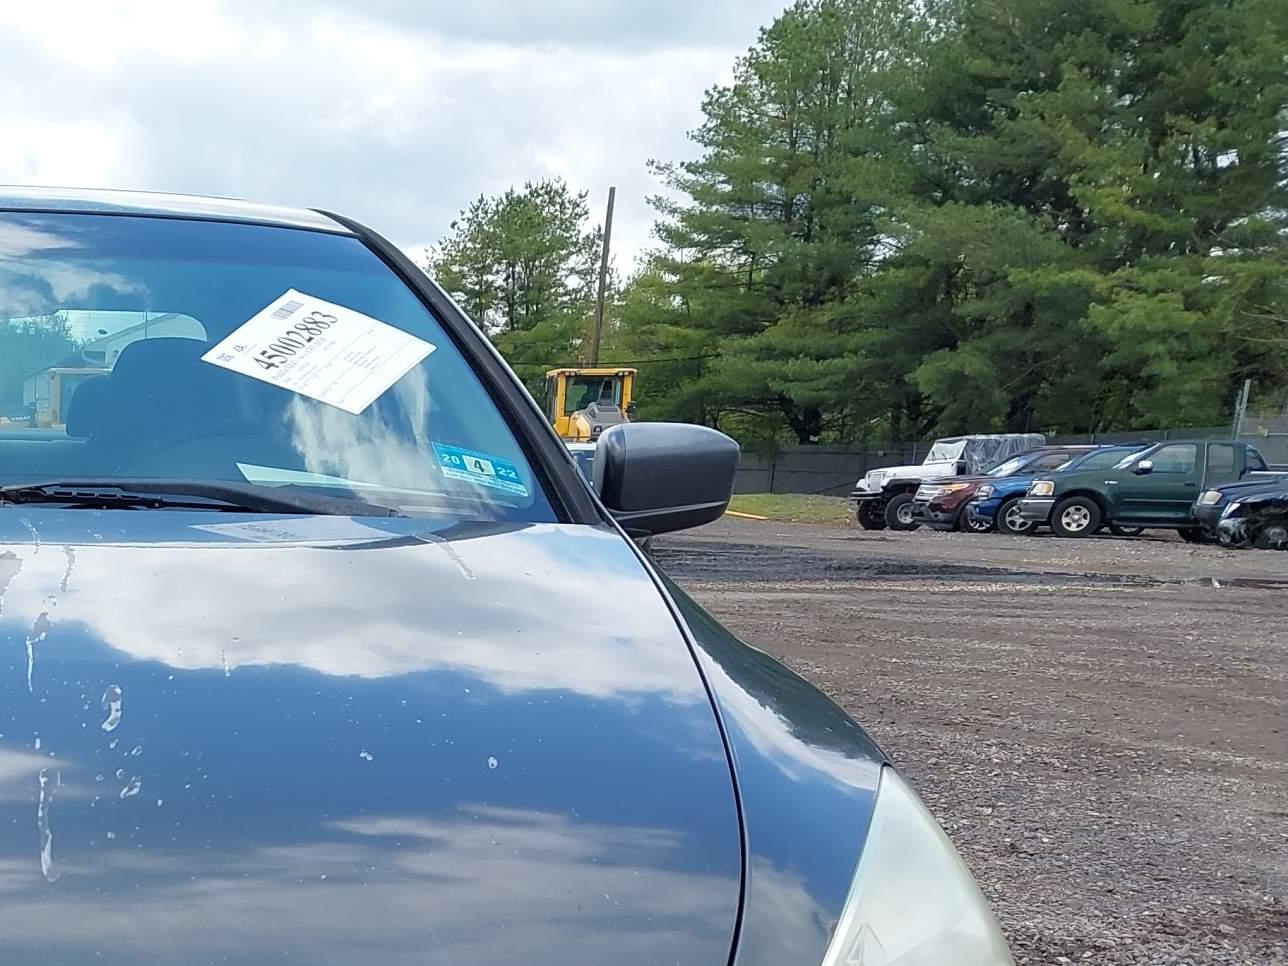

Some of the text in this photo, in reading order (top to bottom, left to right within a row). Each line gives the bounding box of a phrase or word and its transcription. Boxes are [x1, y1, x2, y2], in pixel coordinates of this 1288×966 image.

[253, 311, 338, 370] 45002883
[441, 454, 518, 479] 20 4 22
